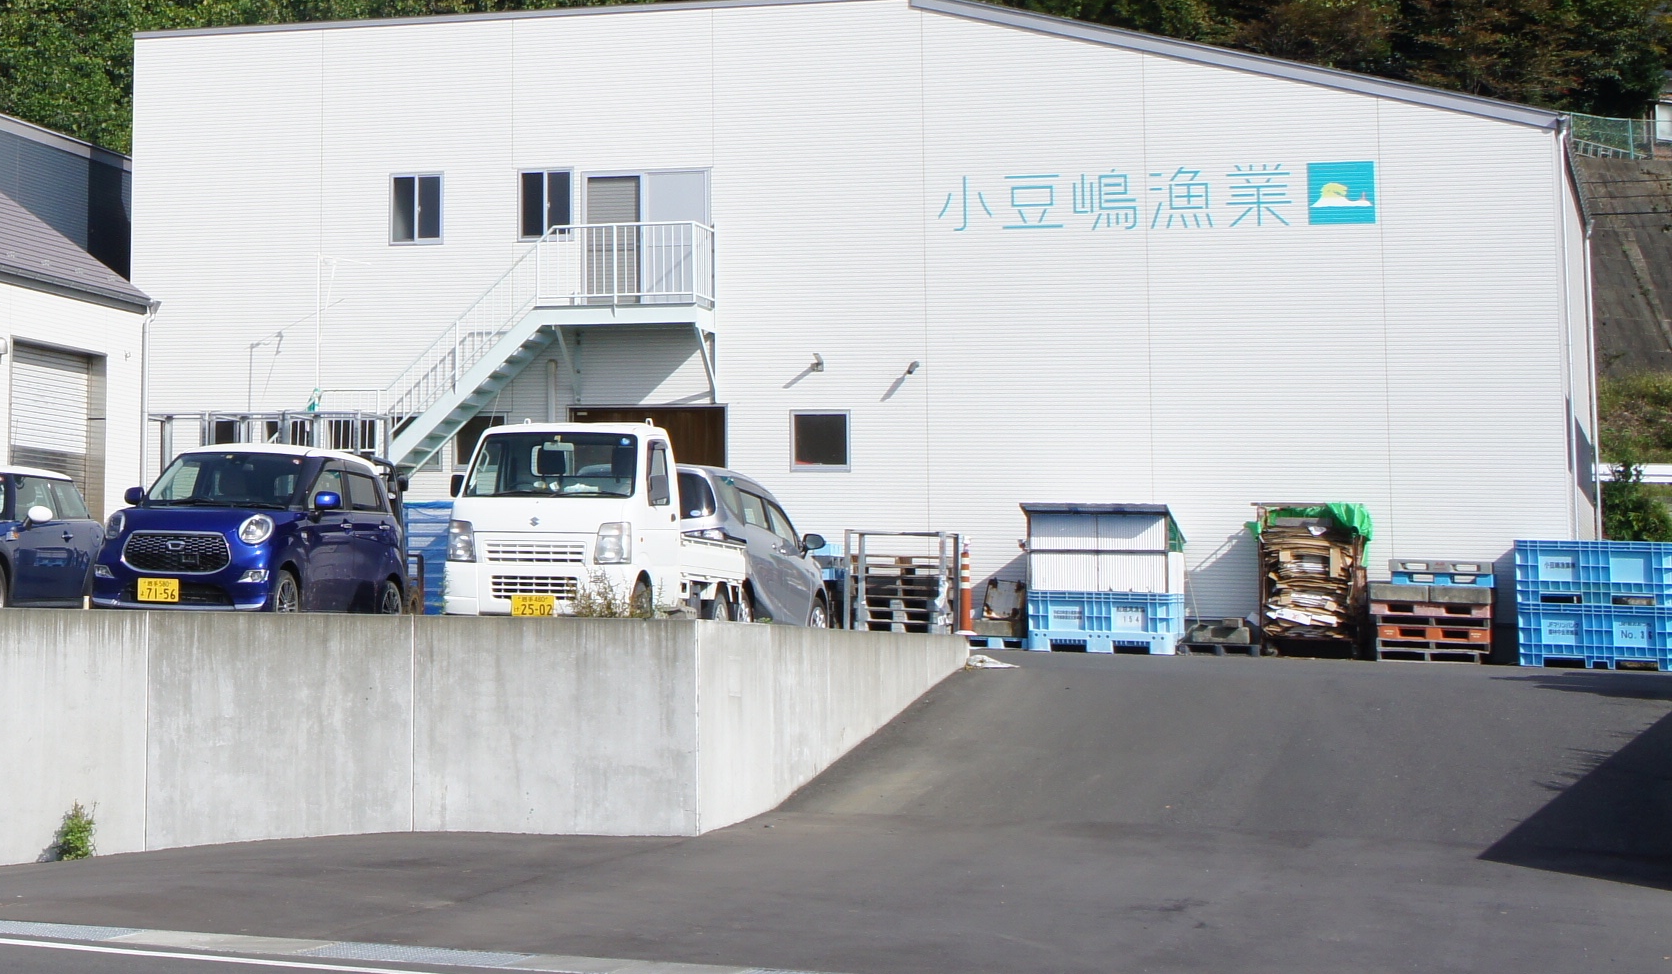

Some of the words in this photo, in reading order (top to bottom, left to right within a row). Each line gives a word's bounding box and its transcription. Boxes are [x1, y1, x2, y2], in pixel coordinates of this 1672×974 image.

[937, 163, 1293, 231] 小豆嶋漁業
[146, 587, 176, 600] 71-56
[521, 603, 553, 616] 25-02
[1122, 615, 1140, 623] 154
